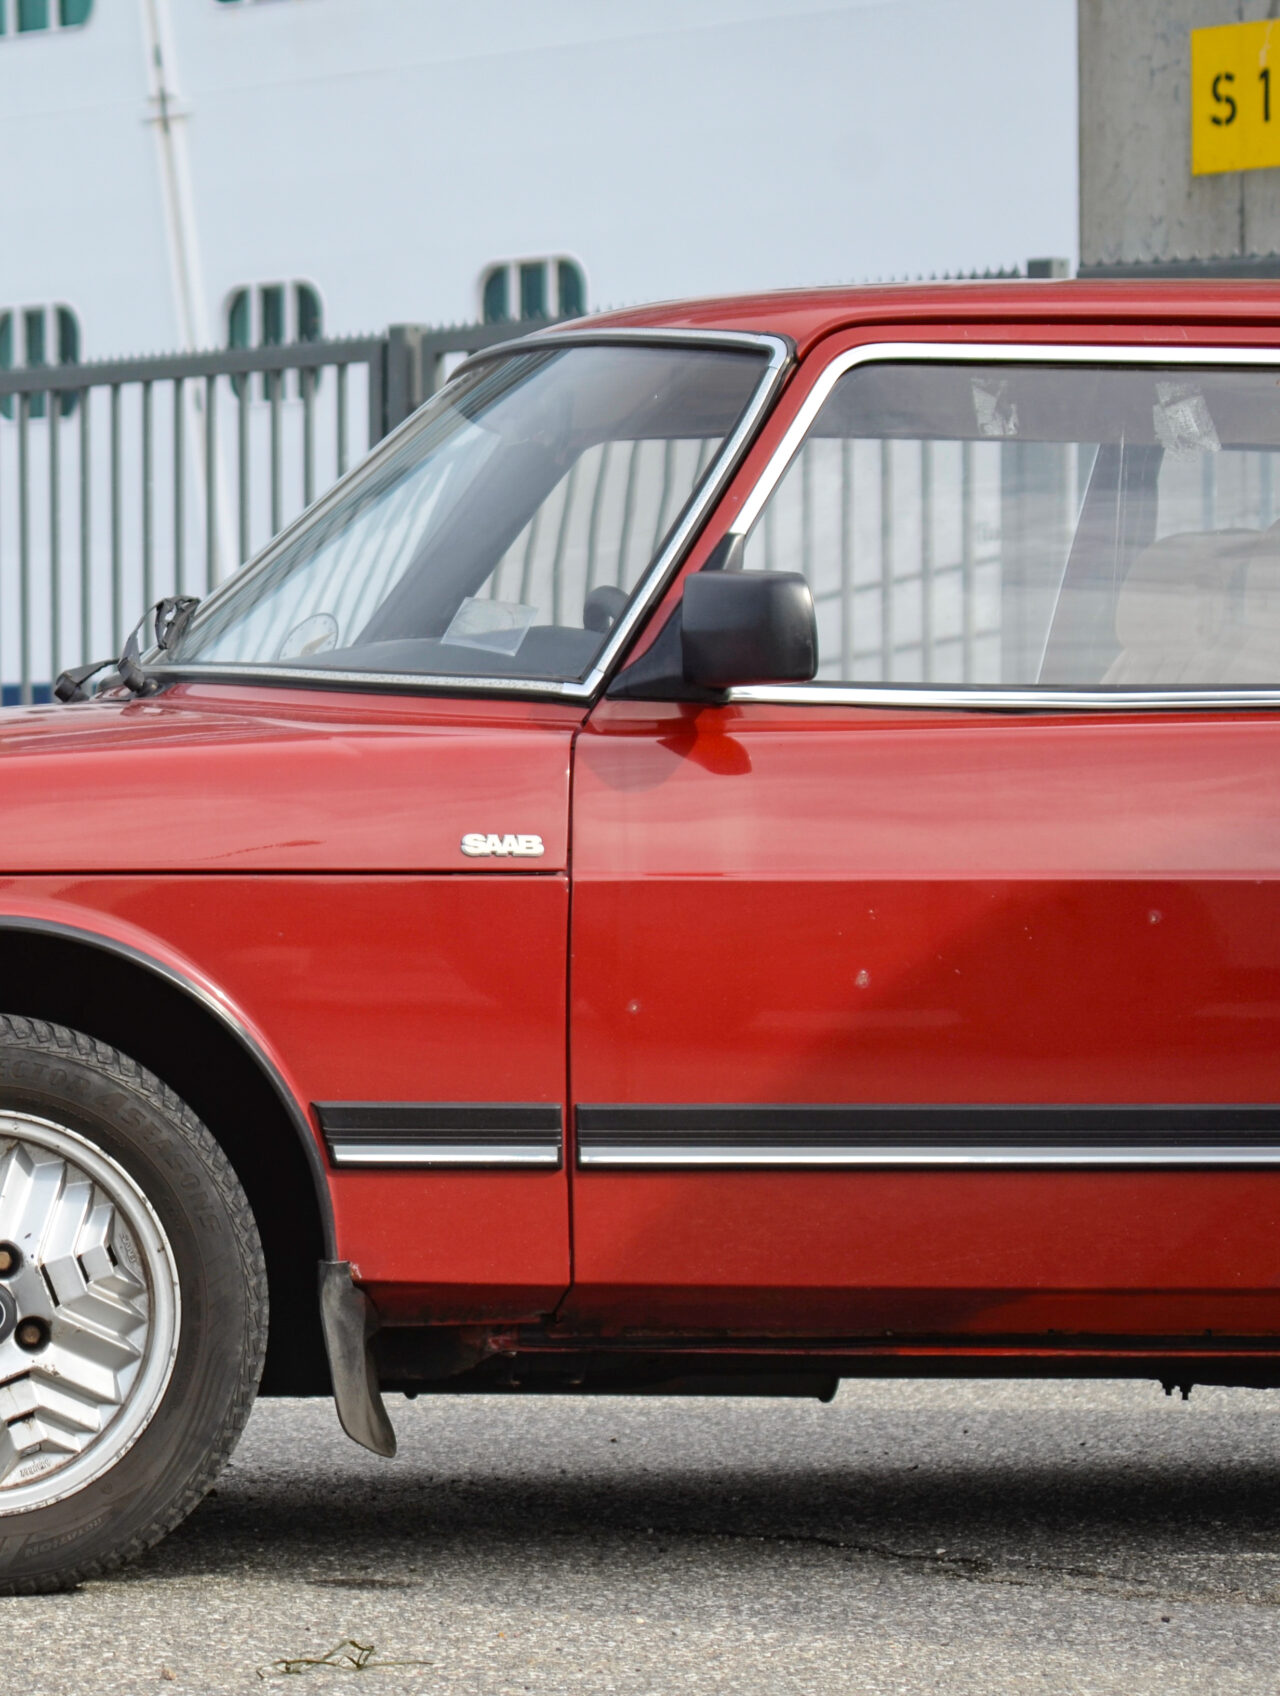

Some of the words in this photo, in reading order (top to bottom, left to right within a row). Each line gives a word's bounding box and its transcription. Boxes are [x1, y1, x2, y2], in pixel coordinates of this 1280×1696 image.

[1210, 72, 1237, 126] S
[1259, 67, 1271, 123] 1
[461, 833, 545, 857] SAAB
